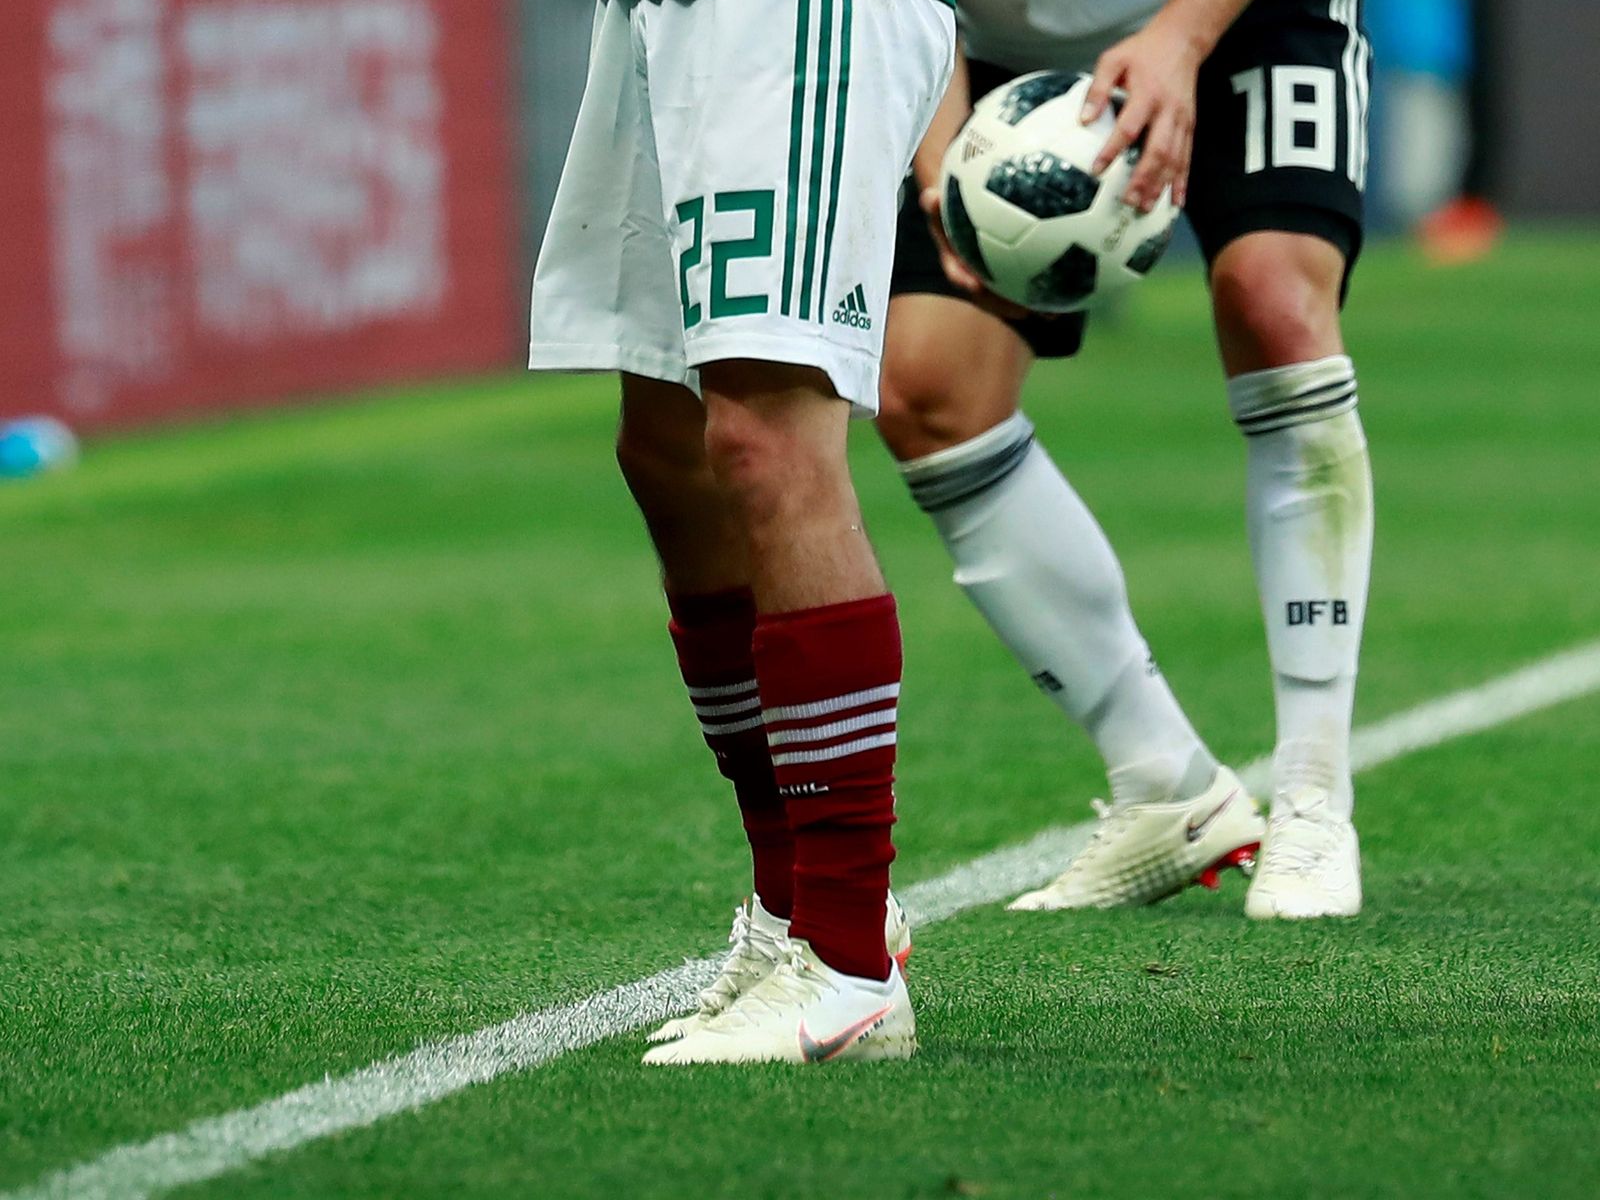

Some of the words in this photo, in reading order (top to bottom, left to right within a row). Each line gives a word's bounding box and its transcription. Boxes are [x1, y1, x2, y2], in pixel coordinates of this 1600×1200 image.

[1229, 65, 1336, 174] 18
[676, 190, 775, 330] 22
[832, 309, 872, 330] adidas
[1287, 600, 1347, 626] DFB
